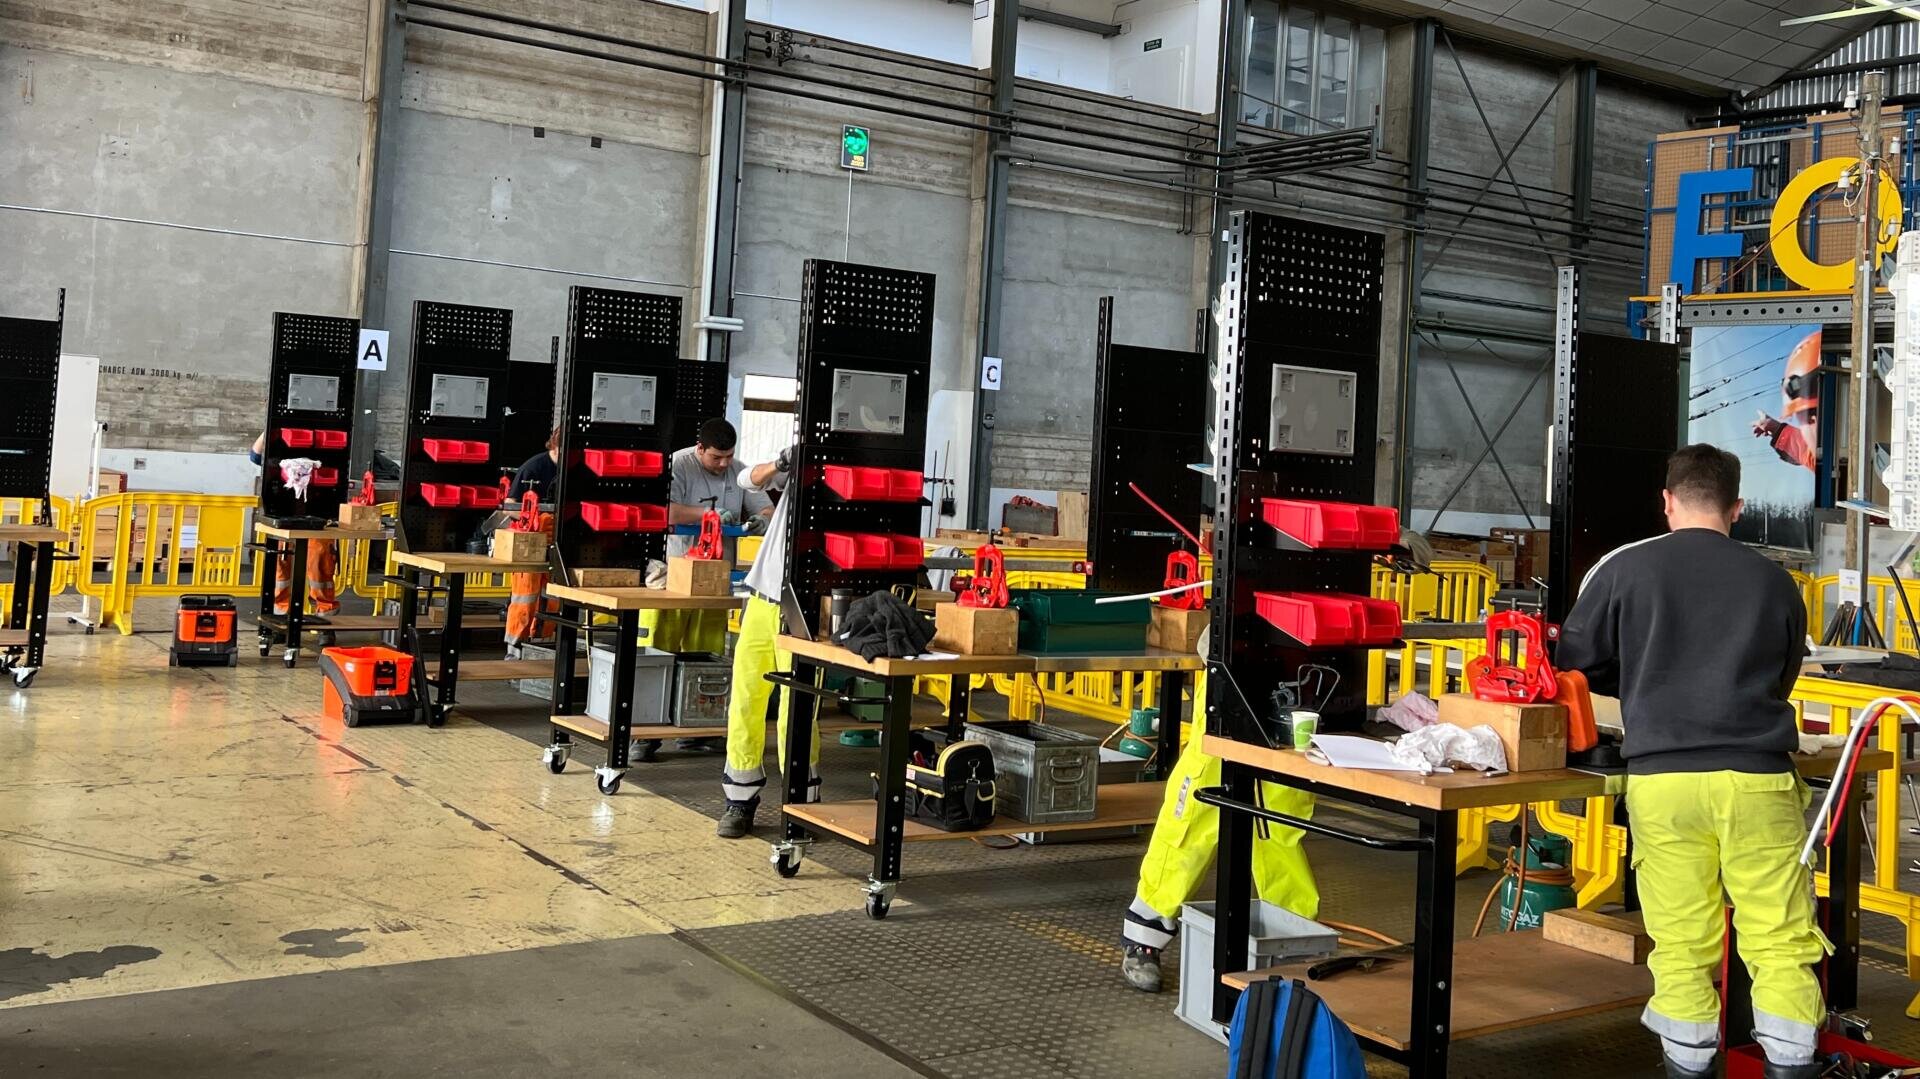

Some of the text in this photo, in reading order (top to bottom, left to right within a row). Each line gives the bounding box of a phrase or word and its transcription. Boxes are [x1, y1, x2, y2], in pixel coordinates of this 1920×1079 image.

[363, 339, 383, 362] A
[151, 368, 170, 378] 3000
[986, 365, 998, 383] C
